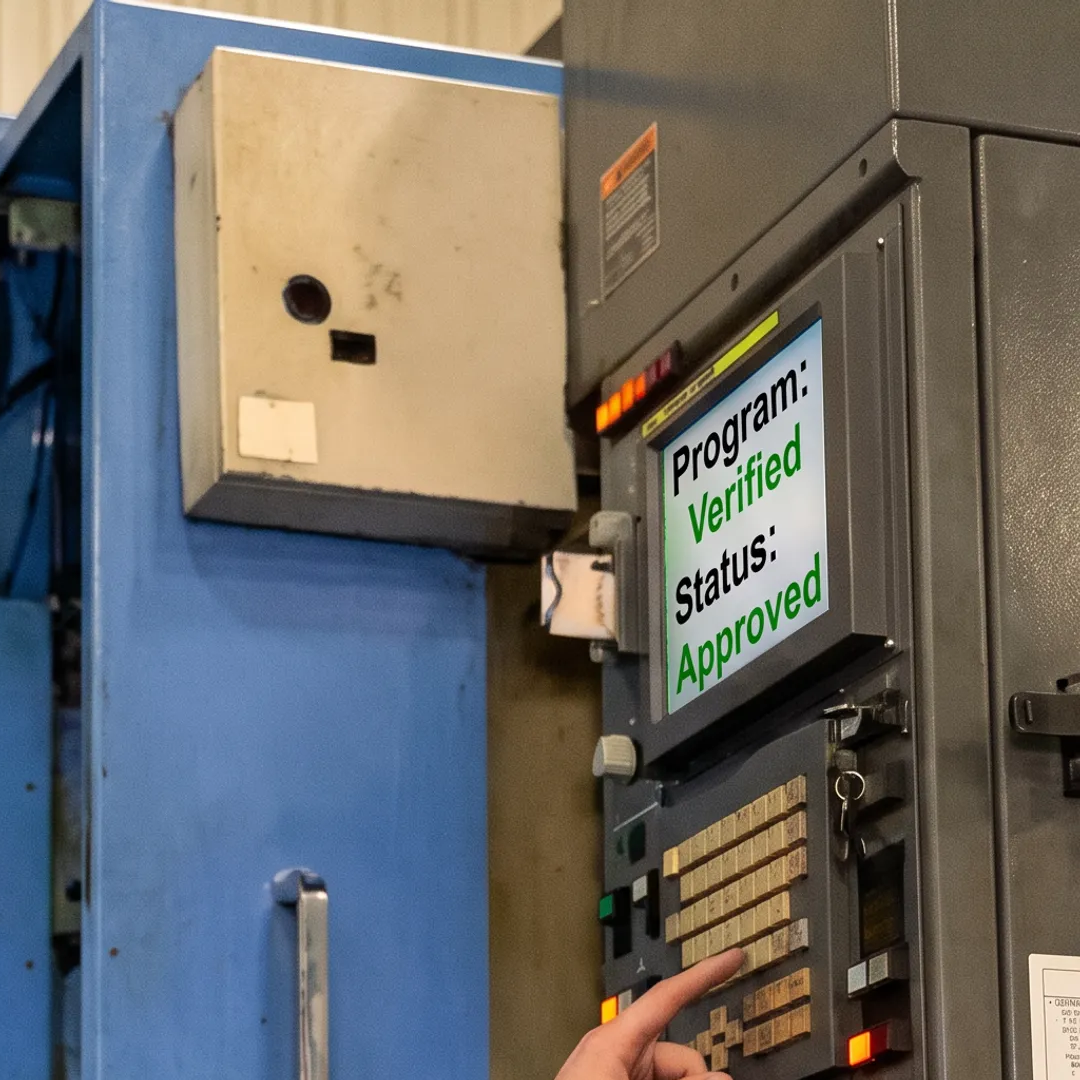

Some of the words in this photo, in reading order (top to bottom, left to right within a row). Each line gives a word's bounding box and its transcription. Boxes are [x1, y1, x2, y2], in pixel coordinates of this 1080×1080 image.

[673, 360, 808, 497] Program:
[688, 424, 801, 544] Verified
[676, 526, 777, 625] Status:
[677, 554, 821, 694] Approved
